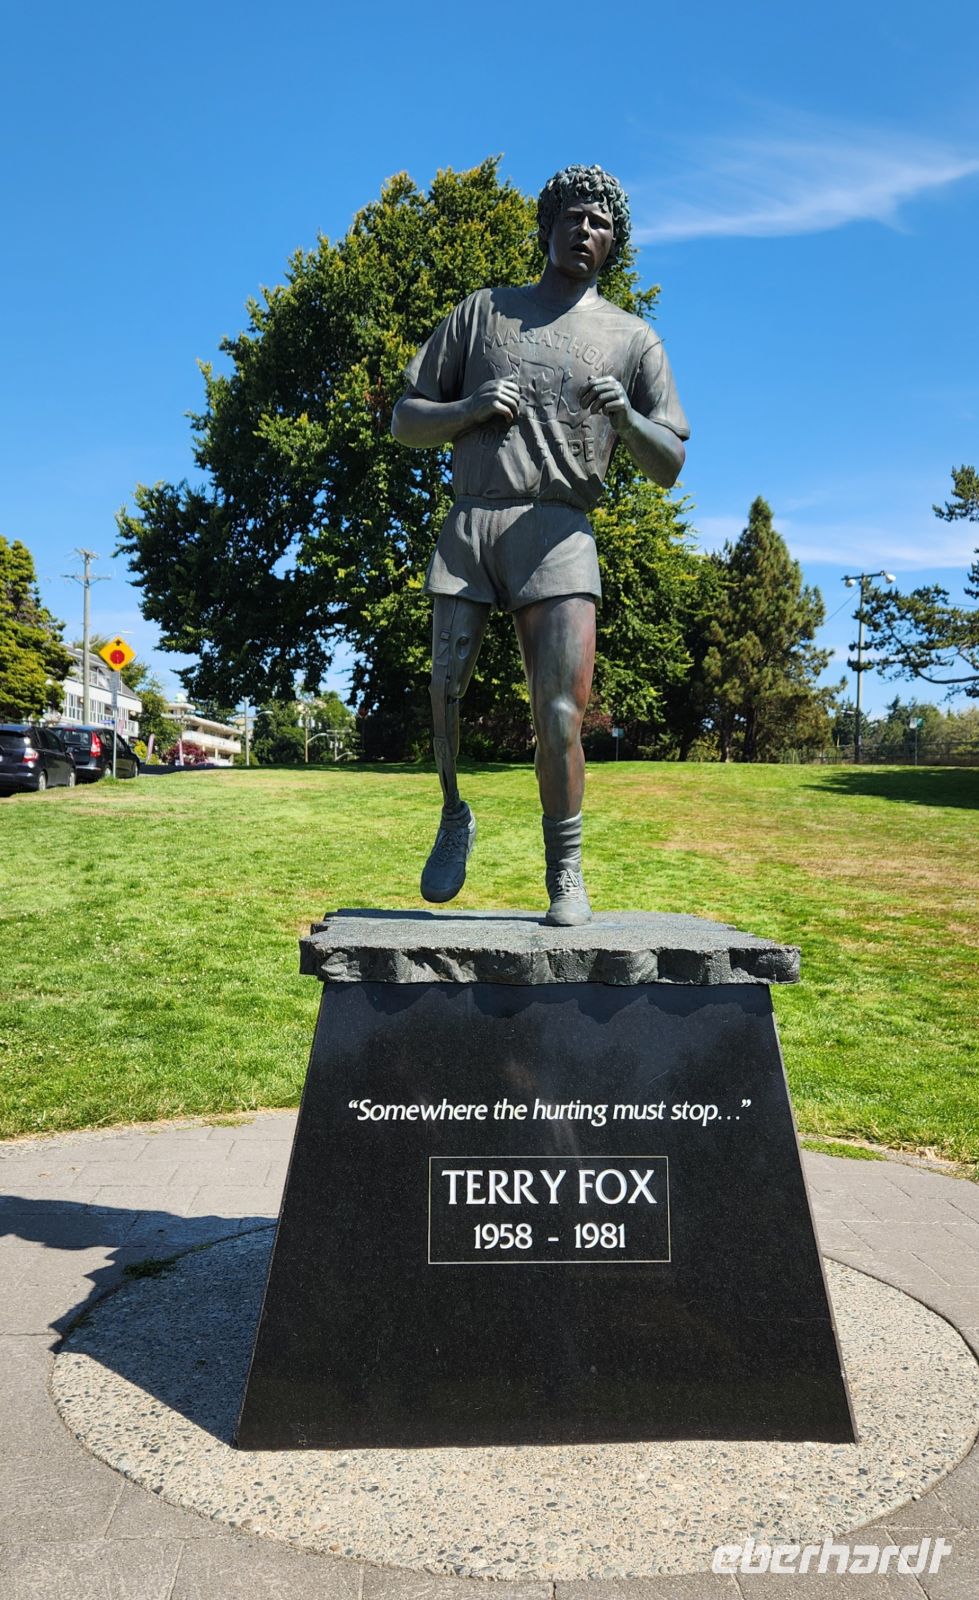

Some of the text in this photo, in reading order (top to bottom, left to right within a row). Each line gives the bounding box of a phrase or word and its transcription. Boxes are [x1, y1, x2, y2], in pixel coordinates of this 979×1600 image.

[482, 327, 616, 377] MARATHON
[493, 1097, 528, 1121] the
[532, 1097, 608, 1127] hurting
[612, 1100, 667, 1121] must
[441, 1168, 658, 1205] TERRY FOX
[473, 1222, 533, 1250] 1958
[573, 1222, 626, 1249] 1981
